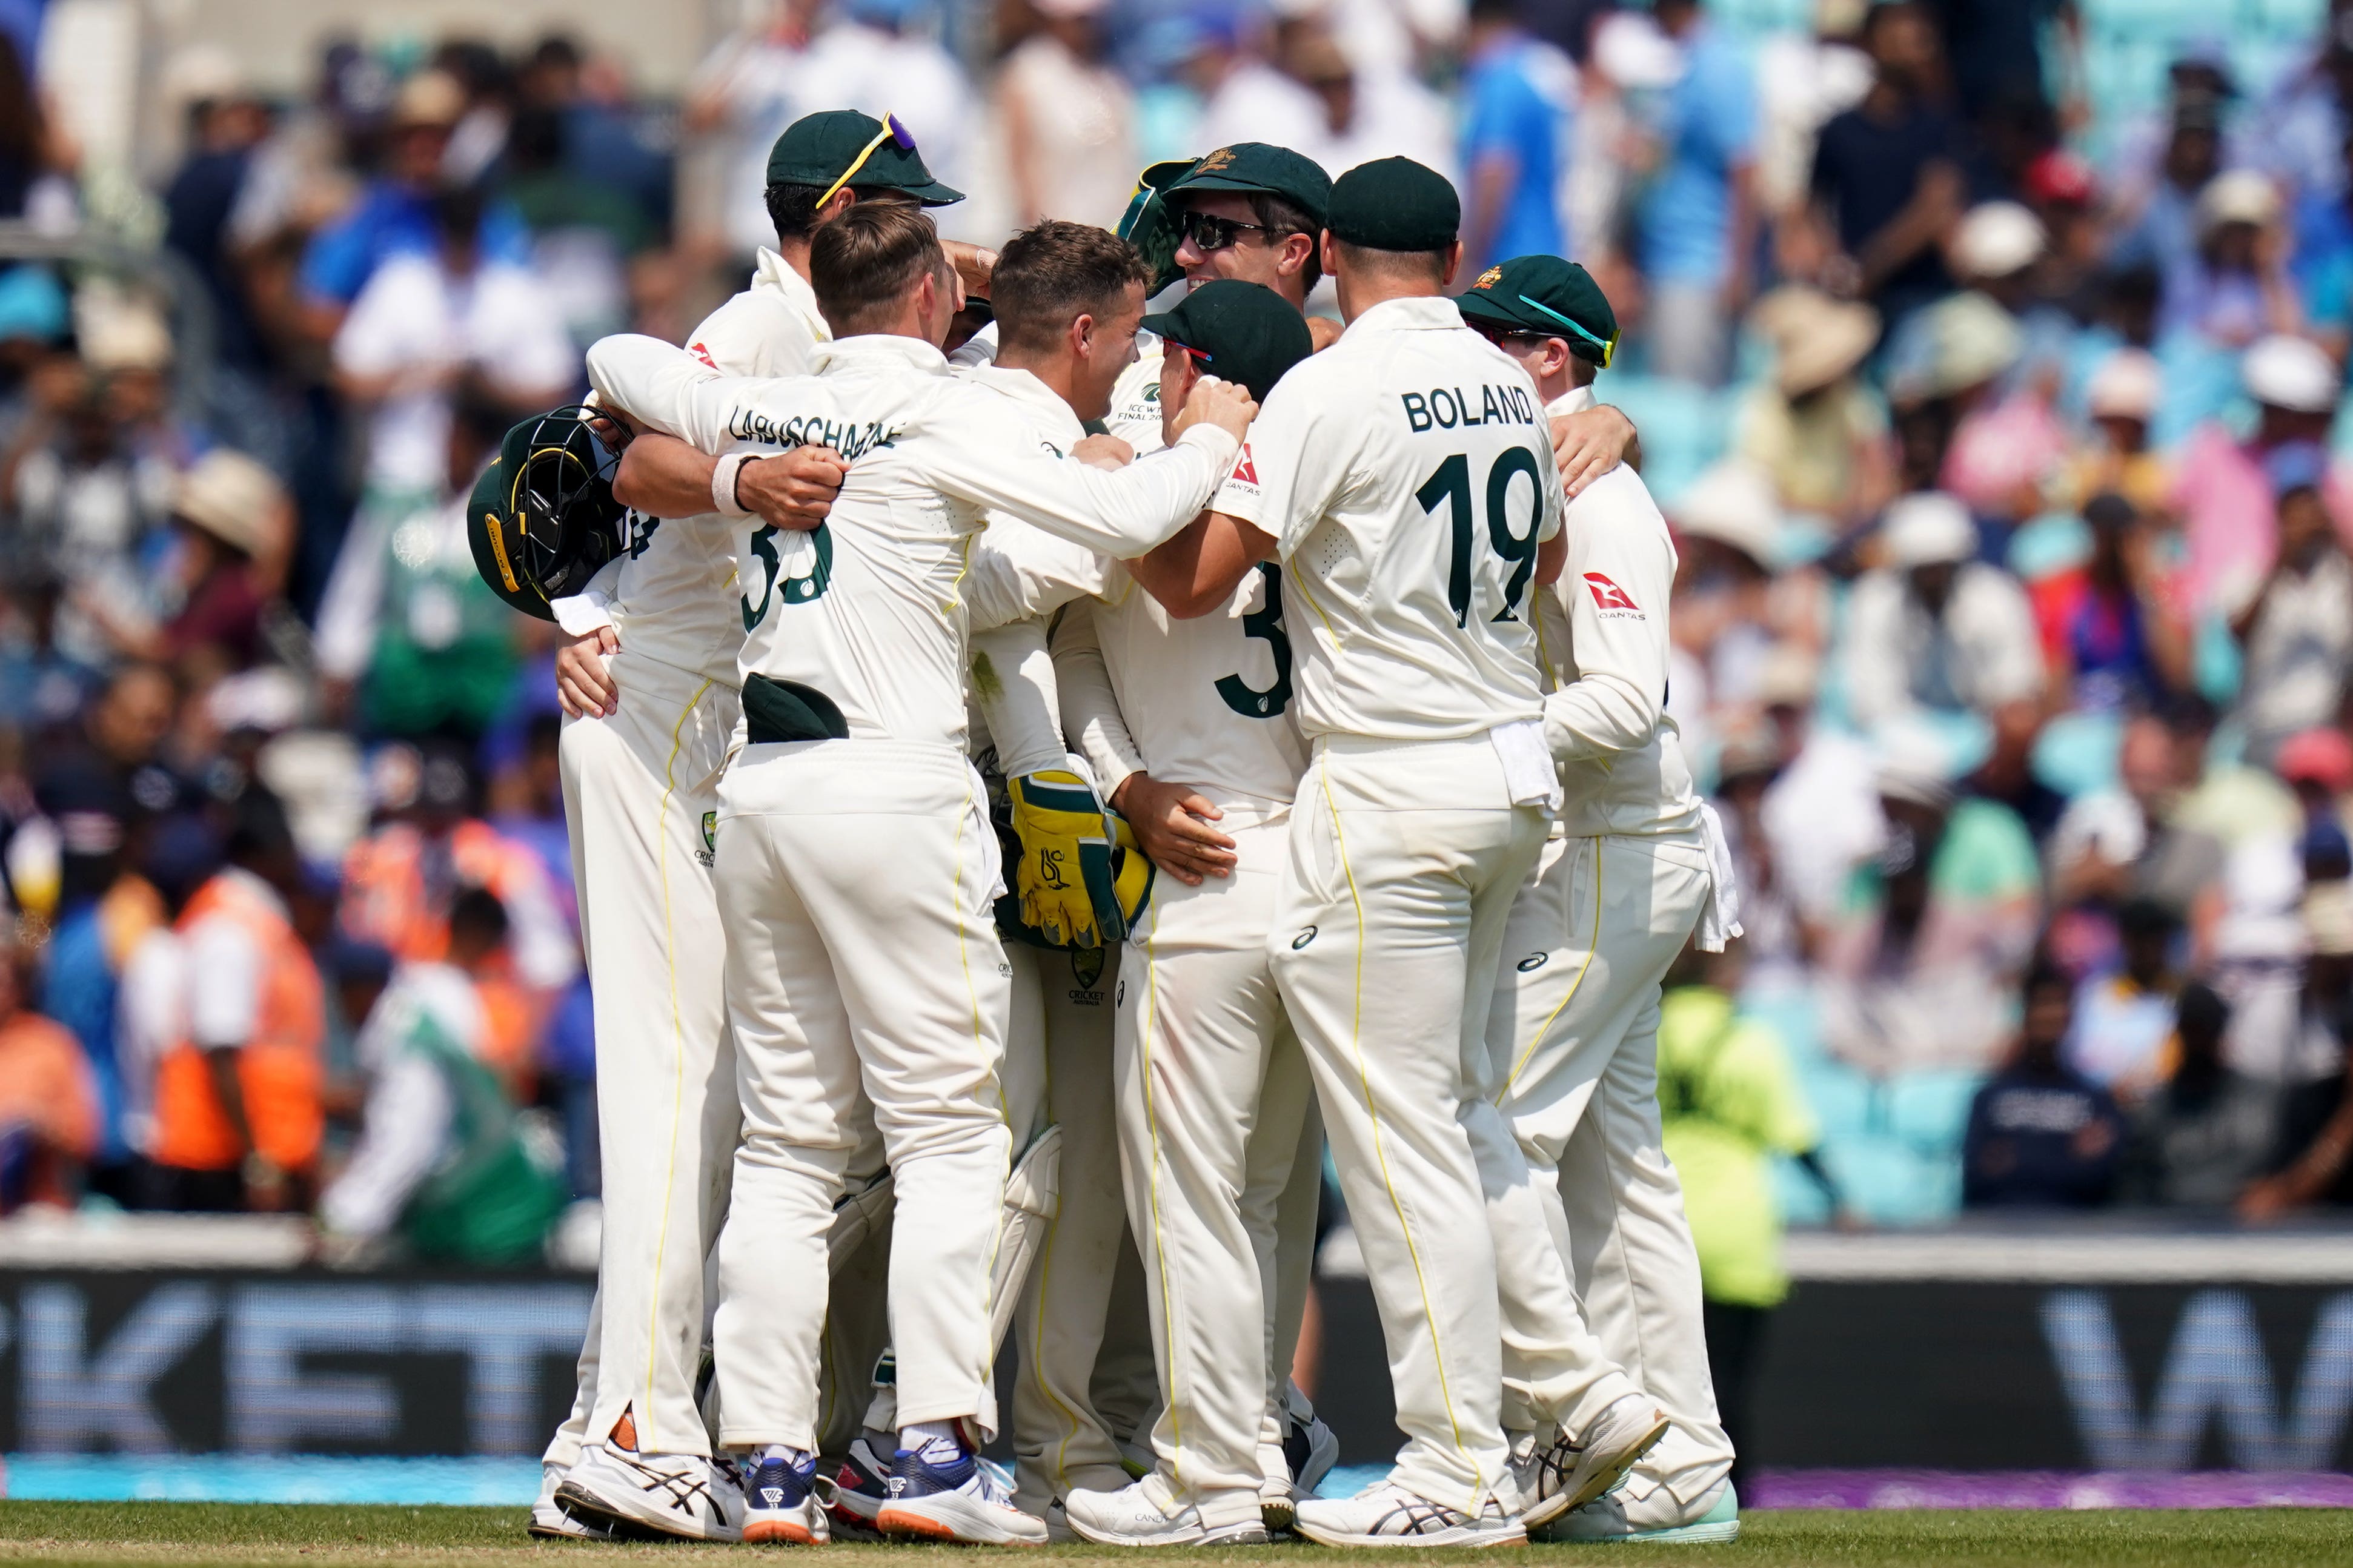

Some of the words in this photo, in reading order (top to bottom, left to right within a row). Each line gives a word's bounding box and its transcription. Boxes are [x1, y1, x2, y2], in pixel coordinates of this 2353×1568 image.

[1401, 384, 1533, 432] BOLAND
[1415, 446, 1543, 629] 19
[1599, 612, 1646, 621] QANTAS
[694, 850, 715, 862] CRIC
[1069, 990, 1105, 1001] CRICKET
[0, 1281, 594, 1455] KET
